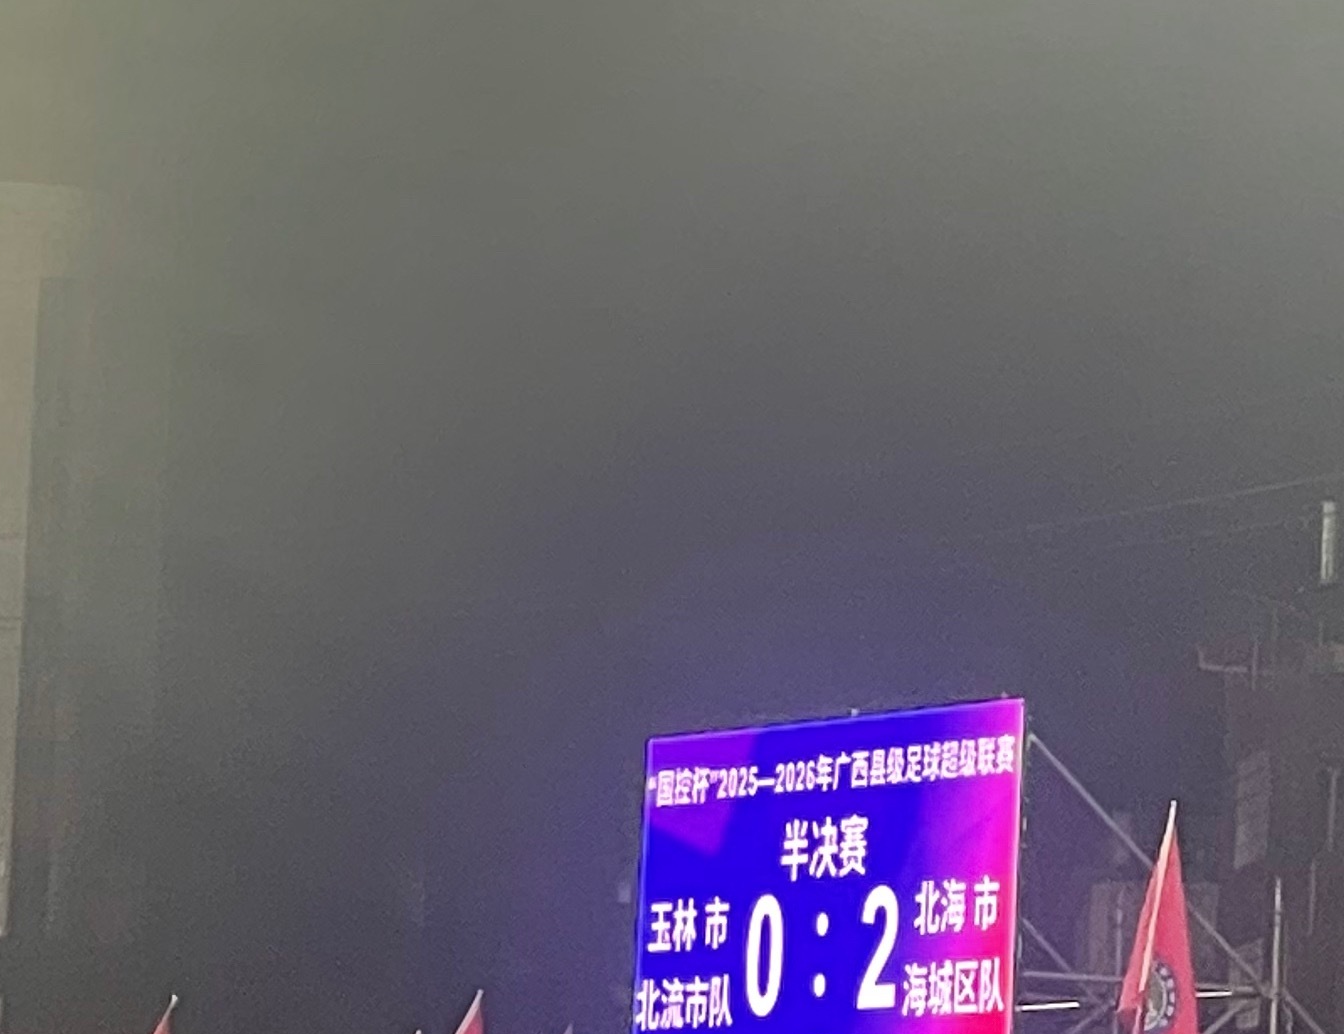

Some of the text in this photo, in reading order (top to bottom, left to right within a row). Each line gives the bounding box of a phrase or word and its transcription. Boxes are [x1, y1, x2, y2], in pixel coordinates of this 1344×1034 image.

[780, 814, 869, 882] 半决赛
[745, 893, 784, 1018] 0
[855, 884, 900, 1011] 2
[635, 974, 733, 1032] 北流市队
[900, 957, 1005, 1017] 海城区队
